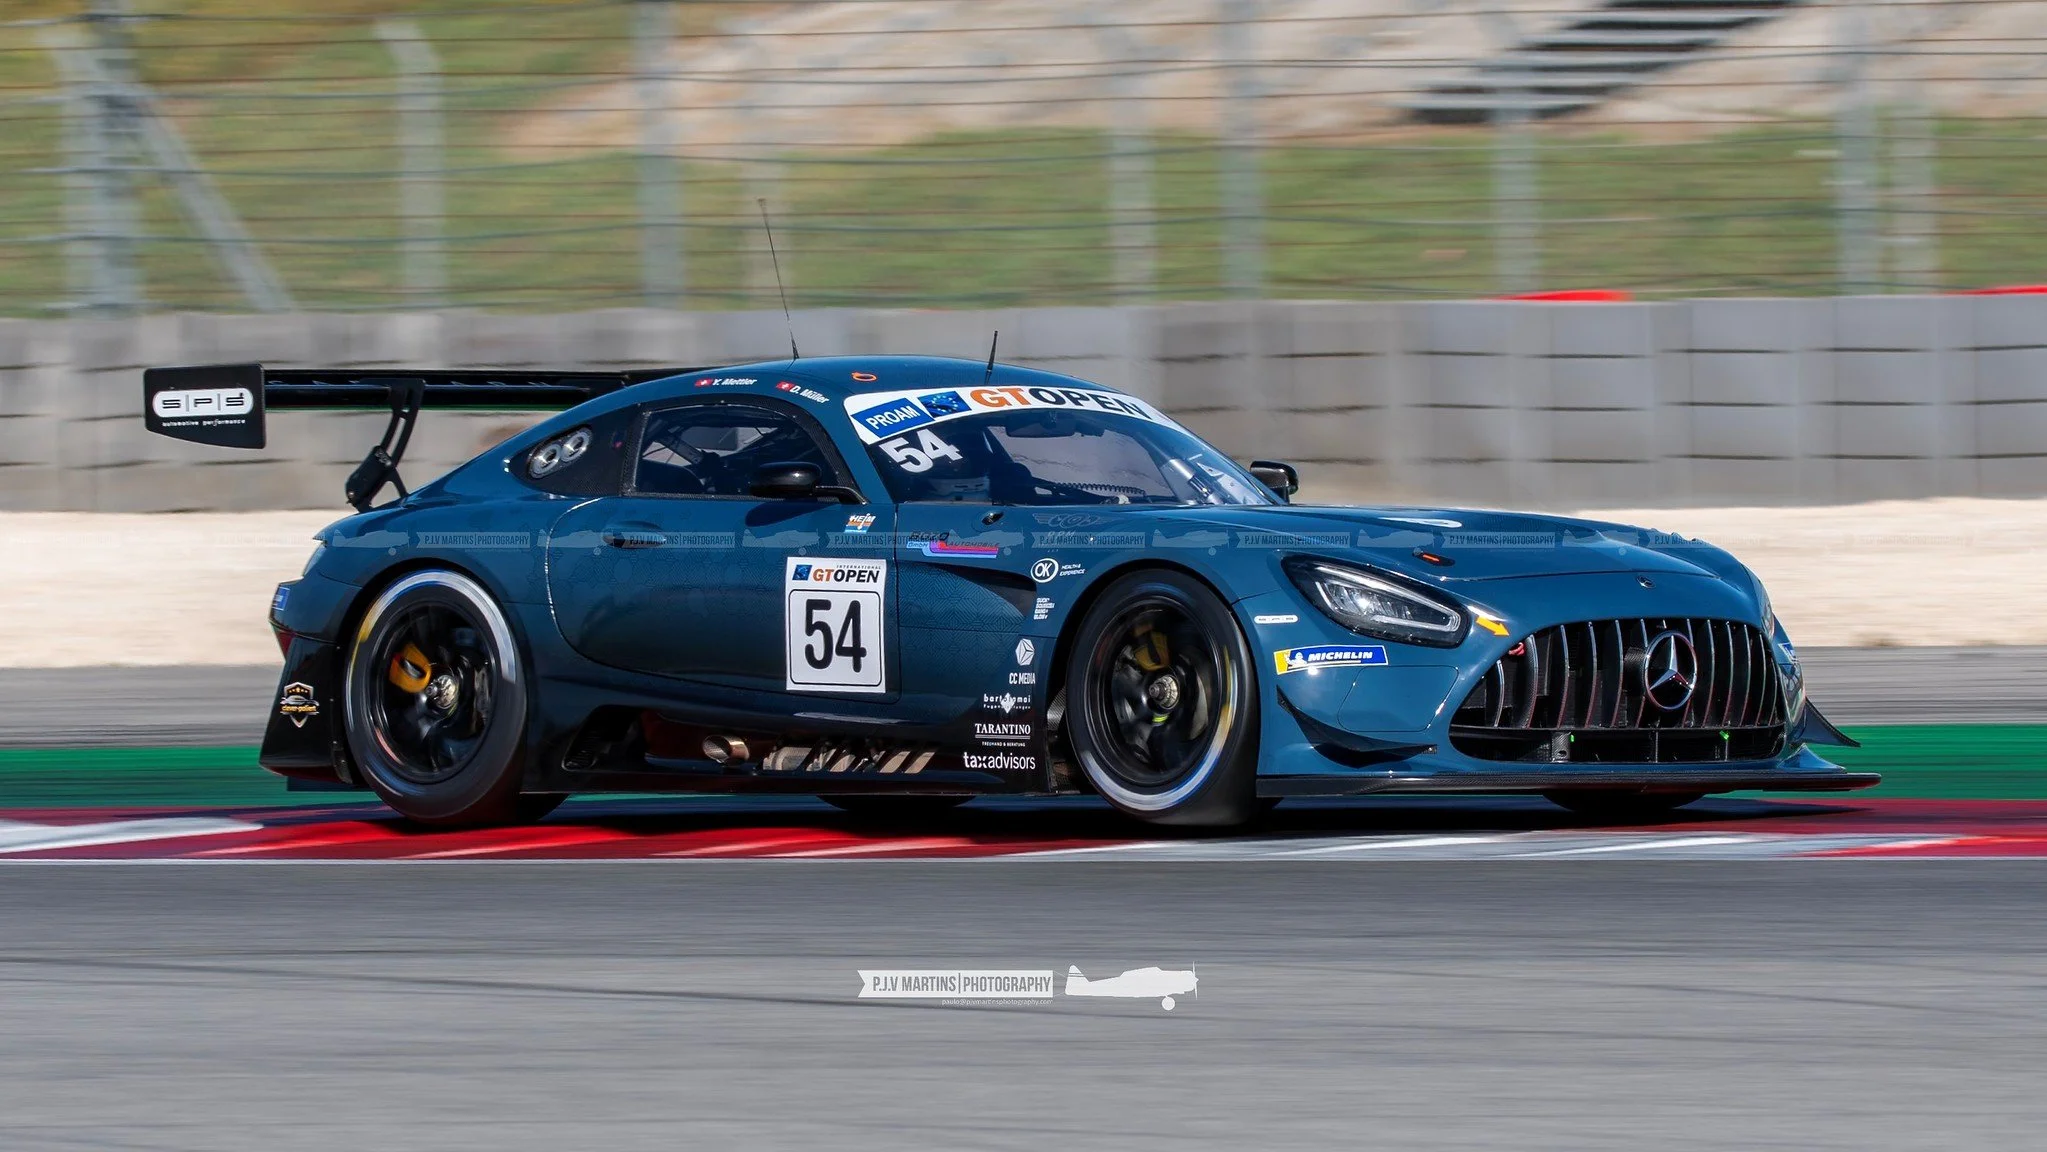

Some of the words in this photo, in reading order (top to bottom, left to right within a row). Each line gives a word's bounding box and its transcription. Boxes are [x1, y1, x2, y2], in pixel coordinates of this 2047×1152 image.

[865, 405, 920, 431] PROAM
[878, 429, 964, 474] 54
[1034, 562, 1052, 577] OK
[804, 598, 867, 673] 54
[1307, 651, 1373, 661] MICHELIN
[1009, 672, 1018, 684] CC
[1018, 672, 1036, 684] MEDIA
[974, 723, 1031, 735] TARANTINO
[963, 751, 1036, 770] taxadvisors
